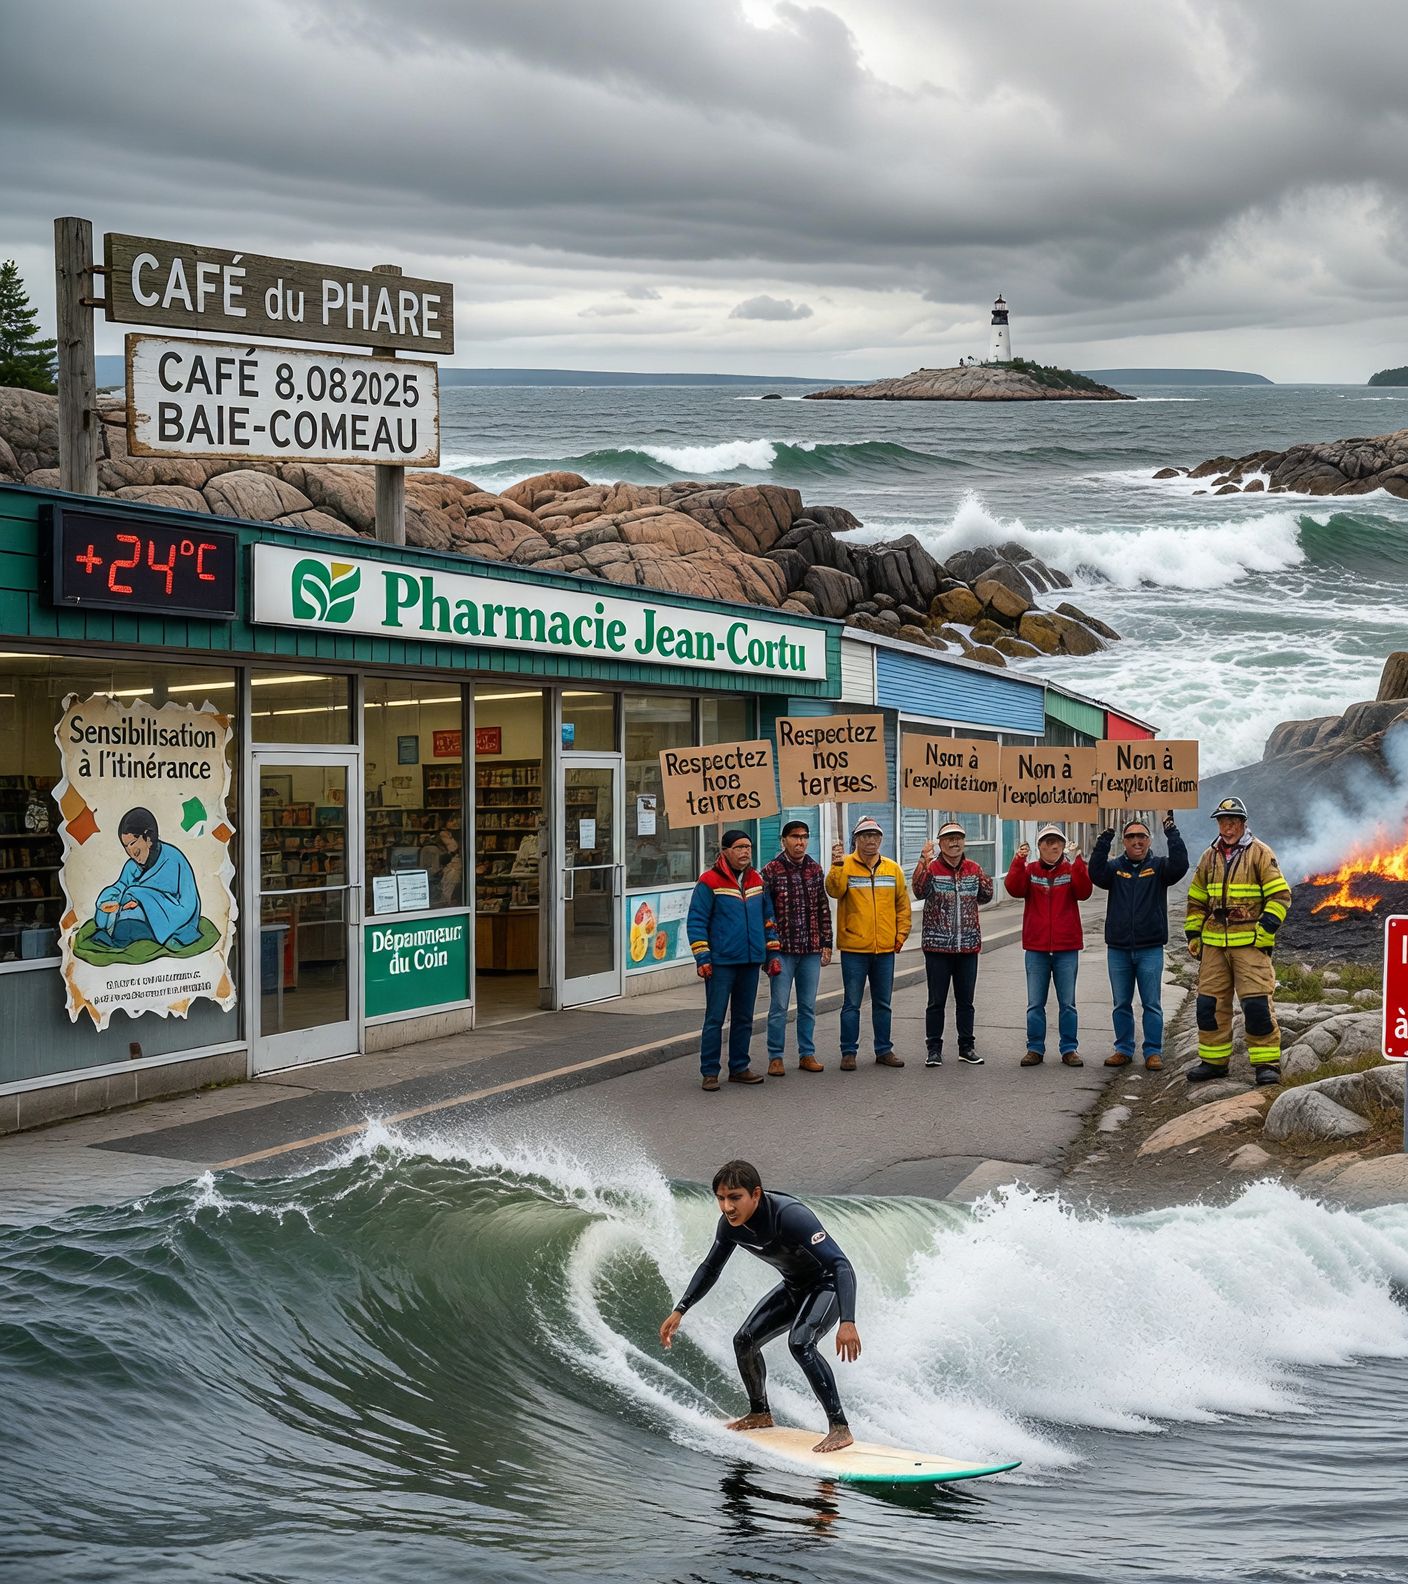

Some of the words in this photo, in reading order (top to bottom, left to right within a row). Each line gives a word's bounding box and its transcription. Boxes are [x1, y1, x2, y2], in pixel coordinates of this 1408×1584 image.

[131, 255, 247, 317] CAFÉ
[265, 278, 304, 322] du
[322, 279, 441, 339] PHARE
[158, 348, 259, 397] CAFÉ
[158, 402, 417, 453] BAIE-COMEAU
[381, 571, 626, 652] Pharmacie
[634, 609, 806, 671] Jean-Cortu
[70, 715, 216, 749] Sensibilisation
[780, 719, 877, 746] Respectez
[79, 749, 91, 777] à
[665, 747, 767, 776] Respectez
[813, 751, 848, 770] nos
[969, 746, 978, 769] à
[1019, 754, 1055, 779] Non
[1062, 754, 1072, 778] à
[1117, 745, 1155, 770] Non
[1163, 747, 1173, 770] à
[389, 951, 410, 975] du
[414, 946, 448, 970] Coin
[1394, 1007, 1408, 1039] à
